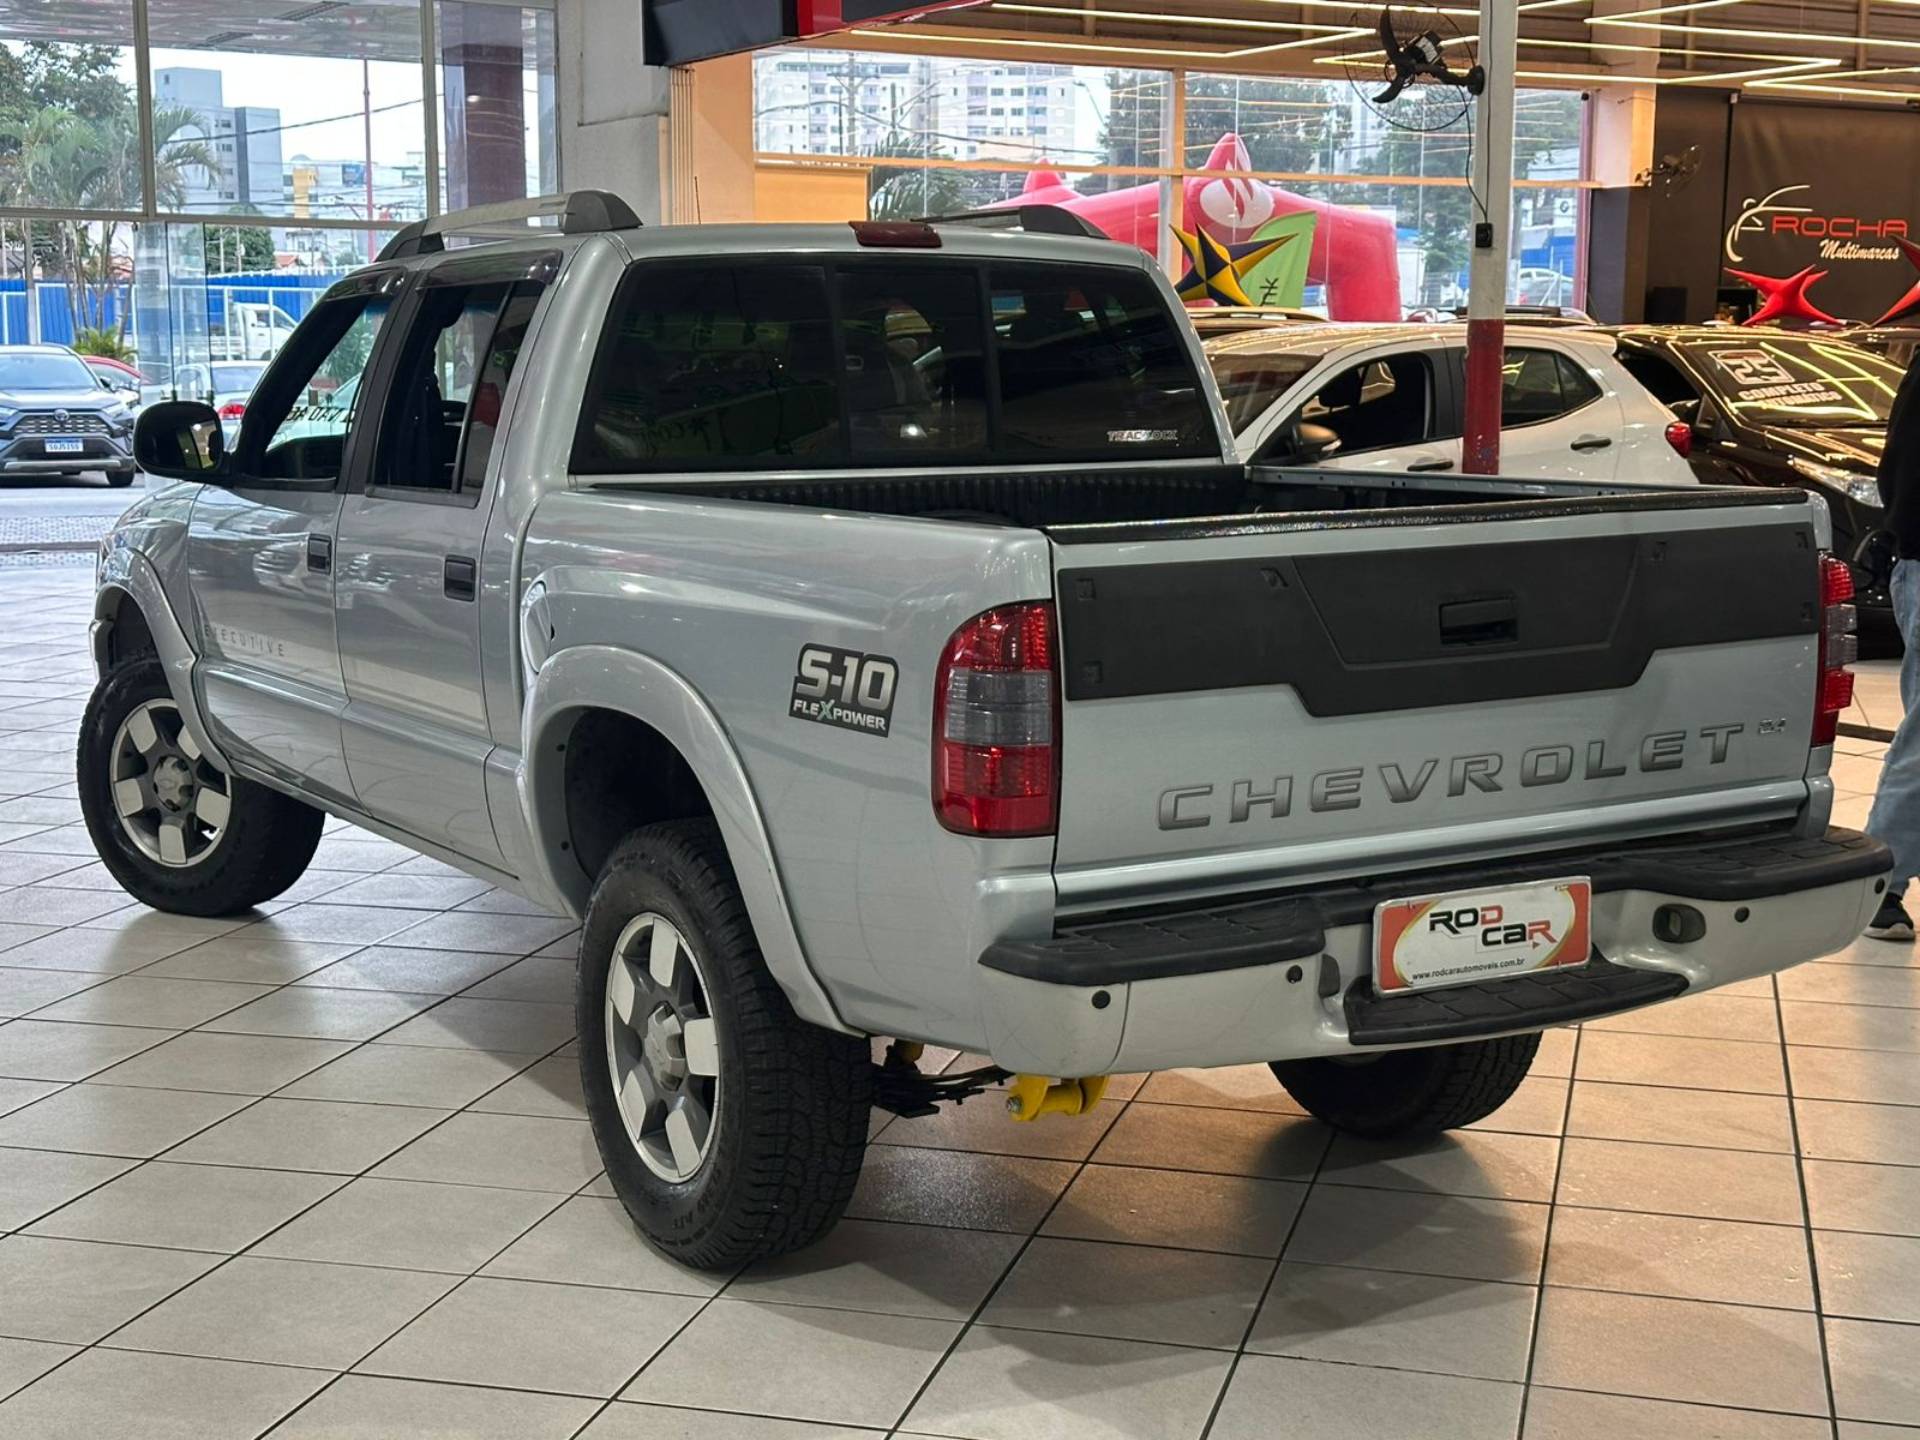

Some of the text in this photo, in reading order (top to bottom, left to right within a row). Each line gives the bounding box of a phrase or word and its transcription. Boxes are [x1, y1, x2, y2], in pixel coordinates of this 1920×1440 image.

[1772, 215, 1908, 238] ROCHA
[1819, 238, 1900, 260] Multimarcas
[795, 648, 896, 711] S-10
[1157, 722, 1745, 831] CHEVROLET
[1412, 957, 1525, 981] www.rodcarautomoveis.com.br
